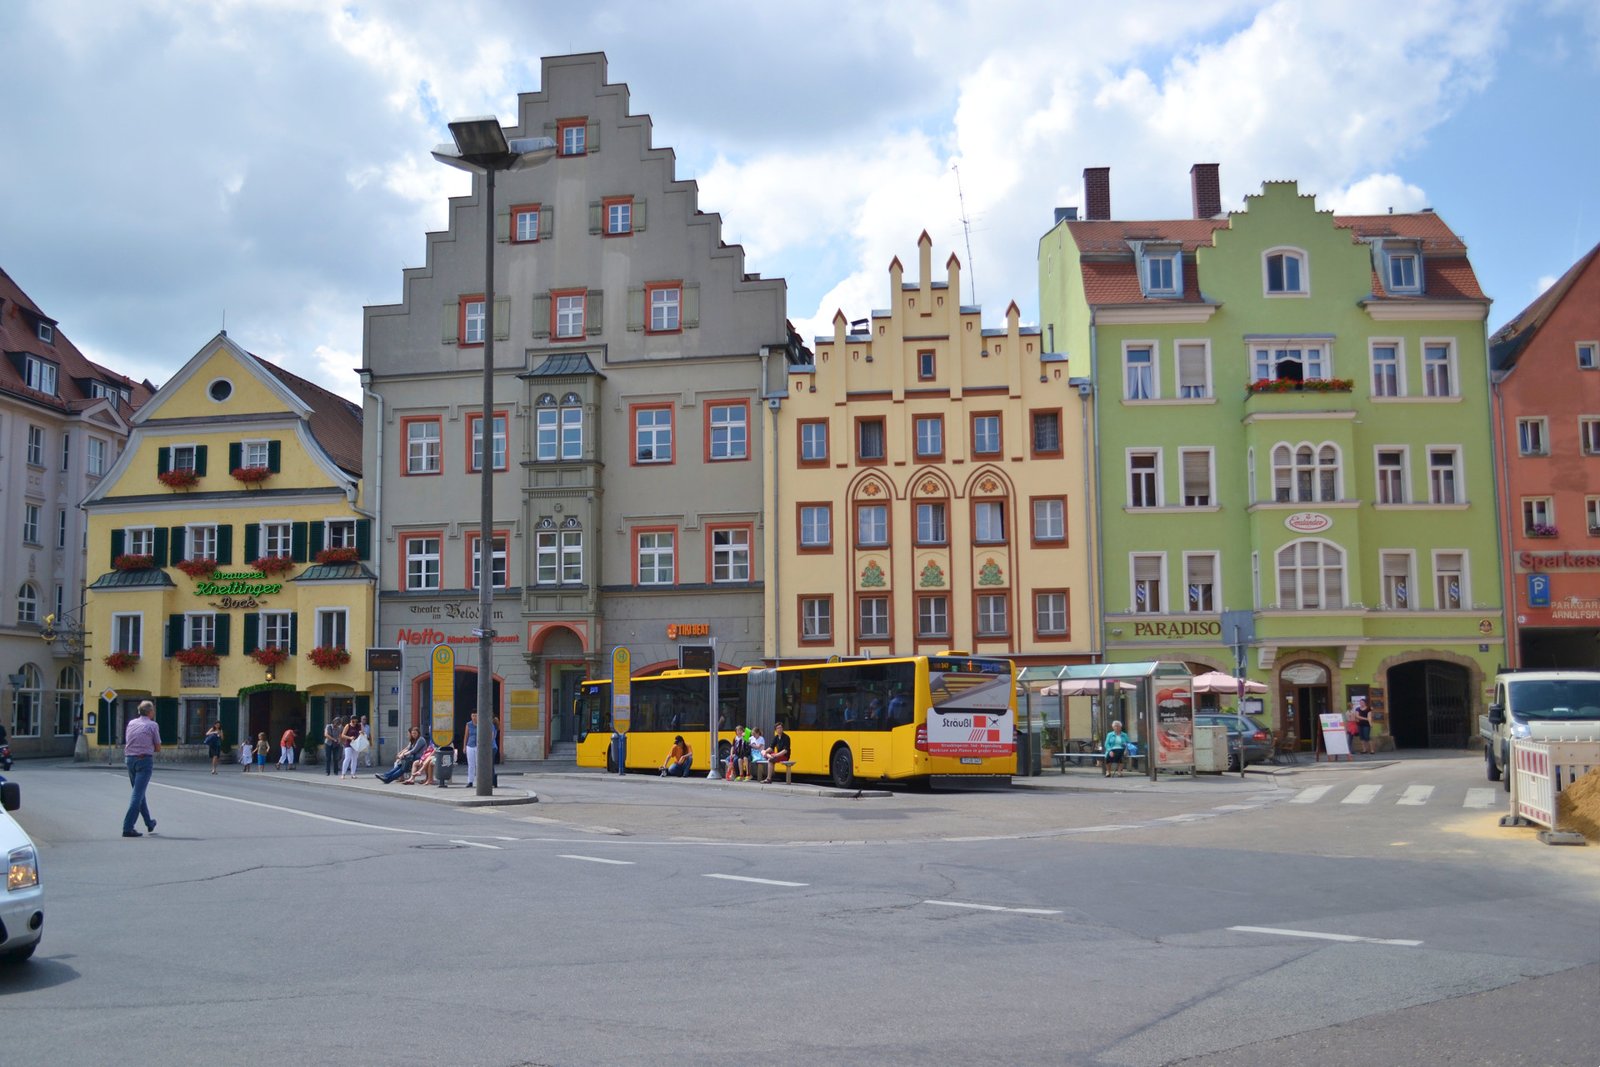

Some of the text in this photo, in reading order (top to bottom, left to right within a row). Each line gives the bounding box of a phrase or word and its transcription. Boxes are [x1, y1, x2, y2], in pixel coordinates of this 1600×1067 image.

[213, 571, 266, 580] Brauerei
[193, 581, 282, 597] Kneitinger
[409, 605, 441, 614] Theater
[444, 602, 504, 620] Velodm
[1551, 601, 1600, 609] PARKGAR
[1134, 622, 1222, 636] PARADISO
[397, 628, 445, 645] Netto
[942, 718, 972, 728] Sträußl
